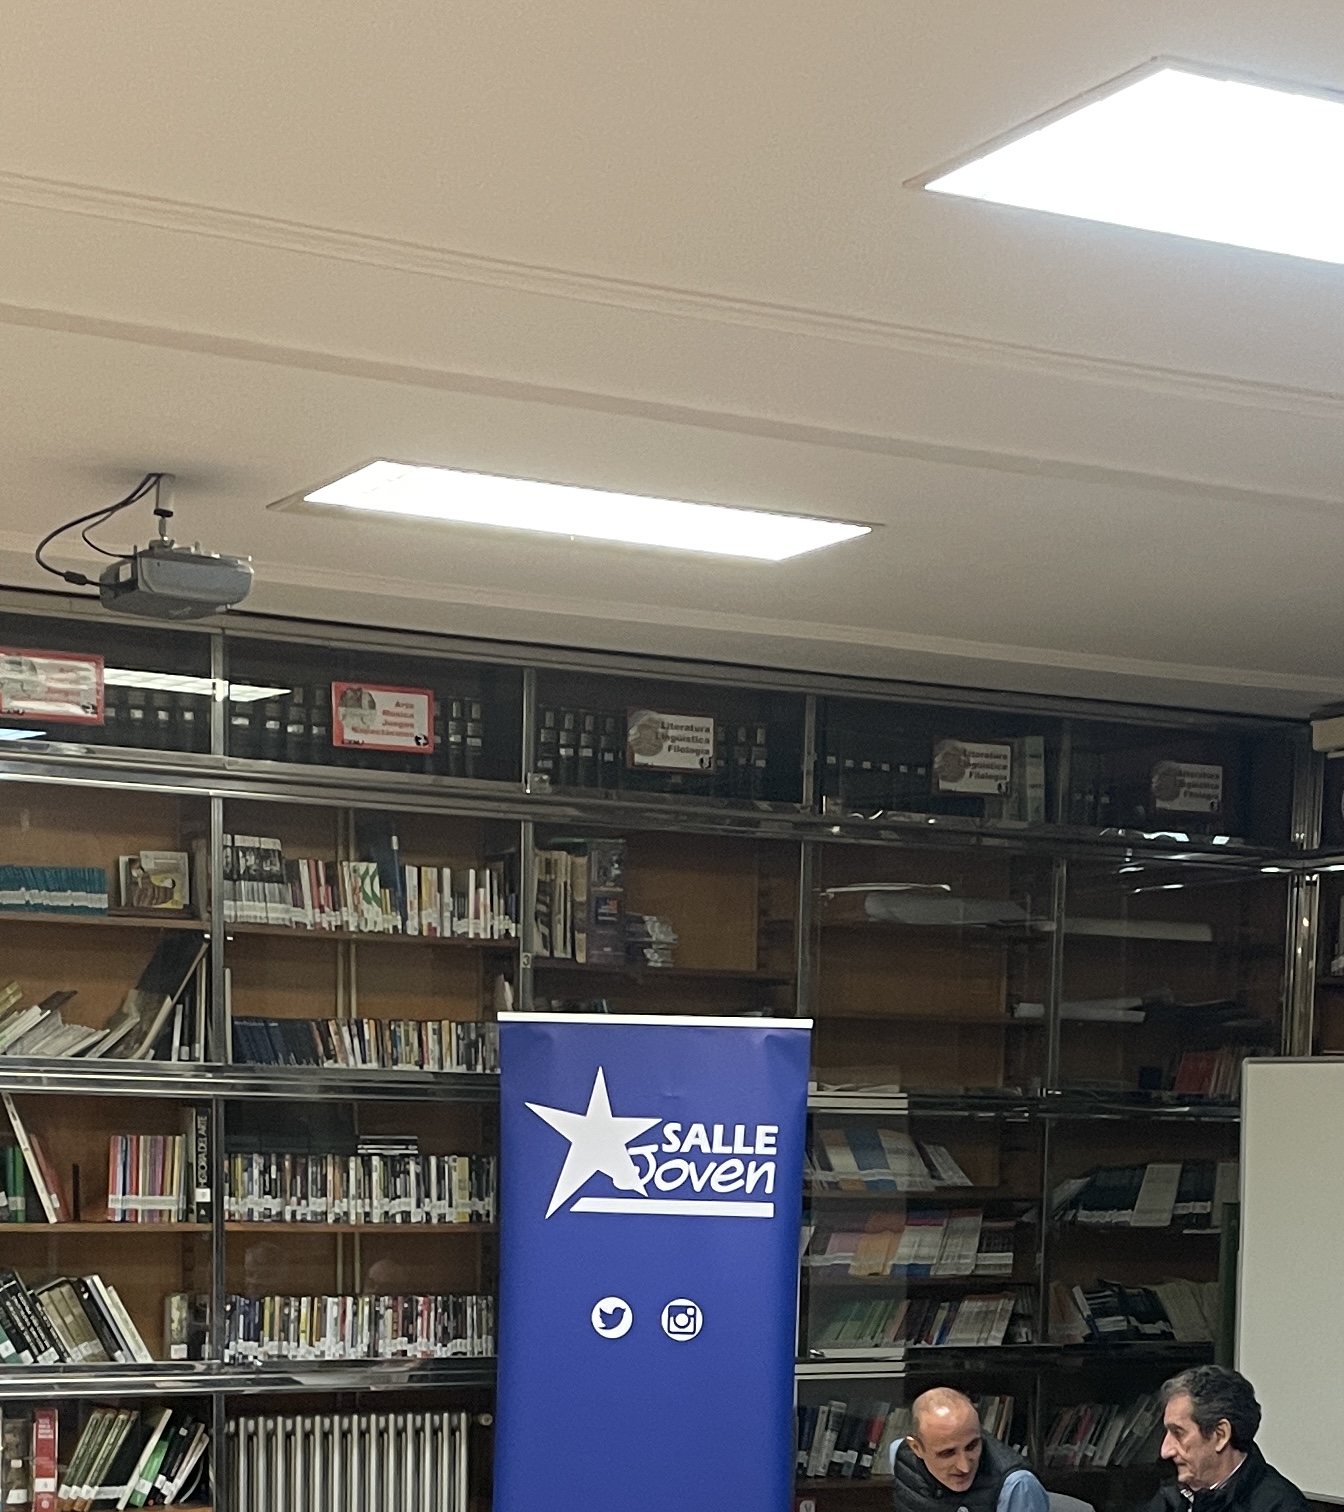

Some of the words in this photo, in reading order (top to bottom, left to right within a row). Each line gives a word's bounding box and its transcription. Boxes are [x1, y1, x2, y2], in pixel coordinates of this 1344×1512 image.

[660, 720, 711, 733] Literatura
[662, 1122, 779, 1156] SALLE
[613, 1144, 777, 1194] Joven
